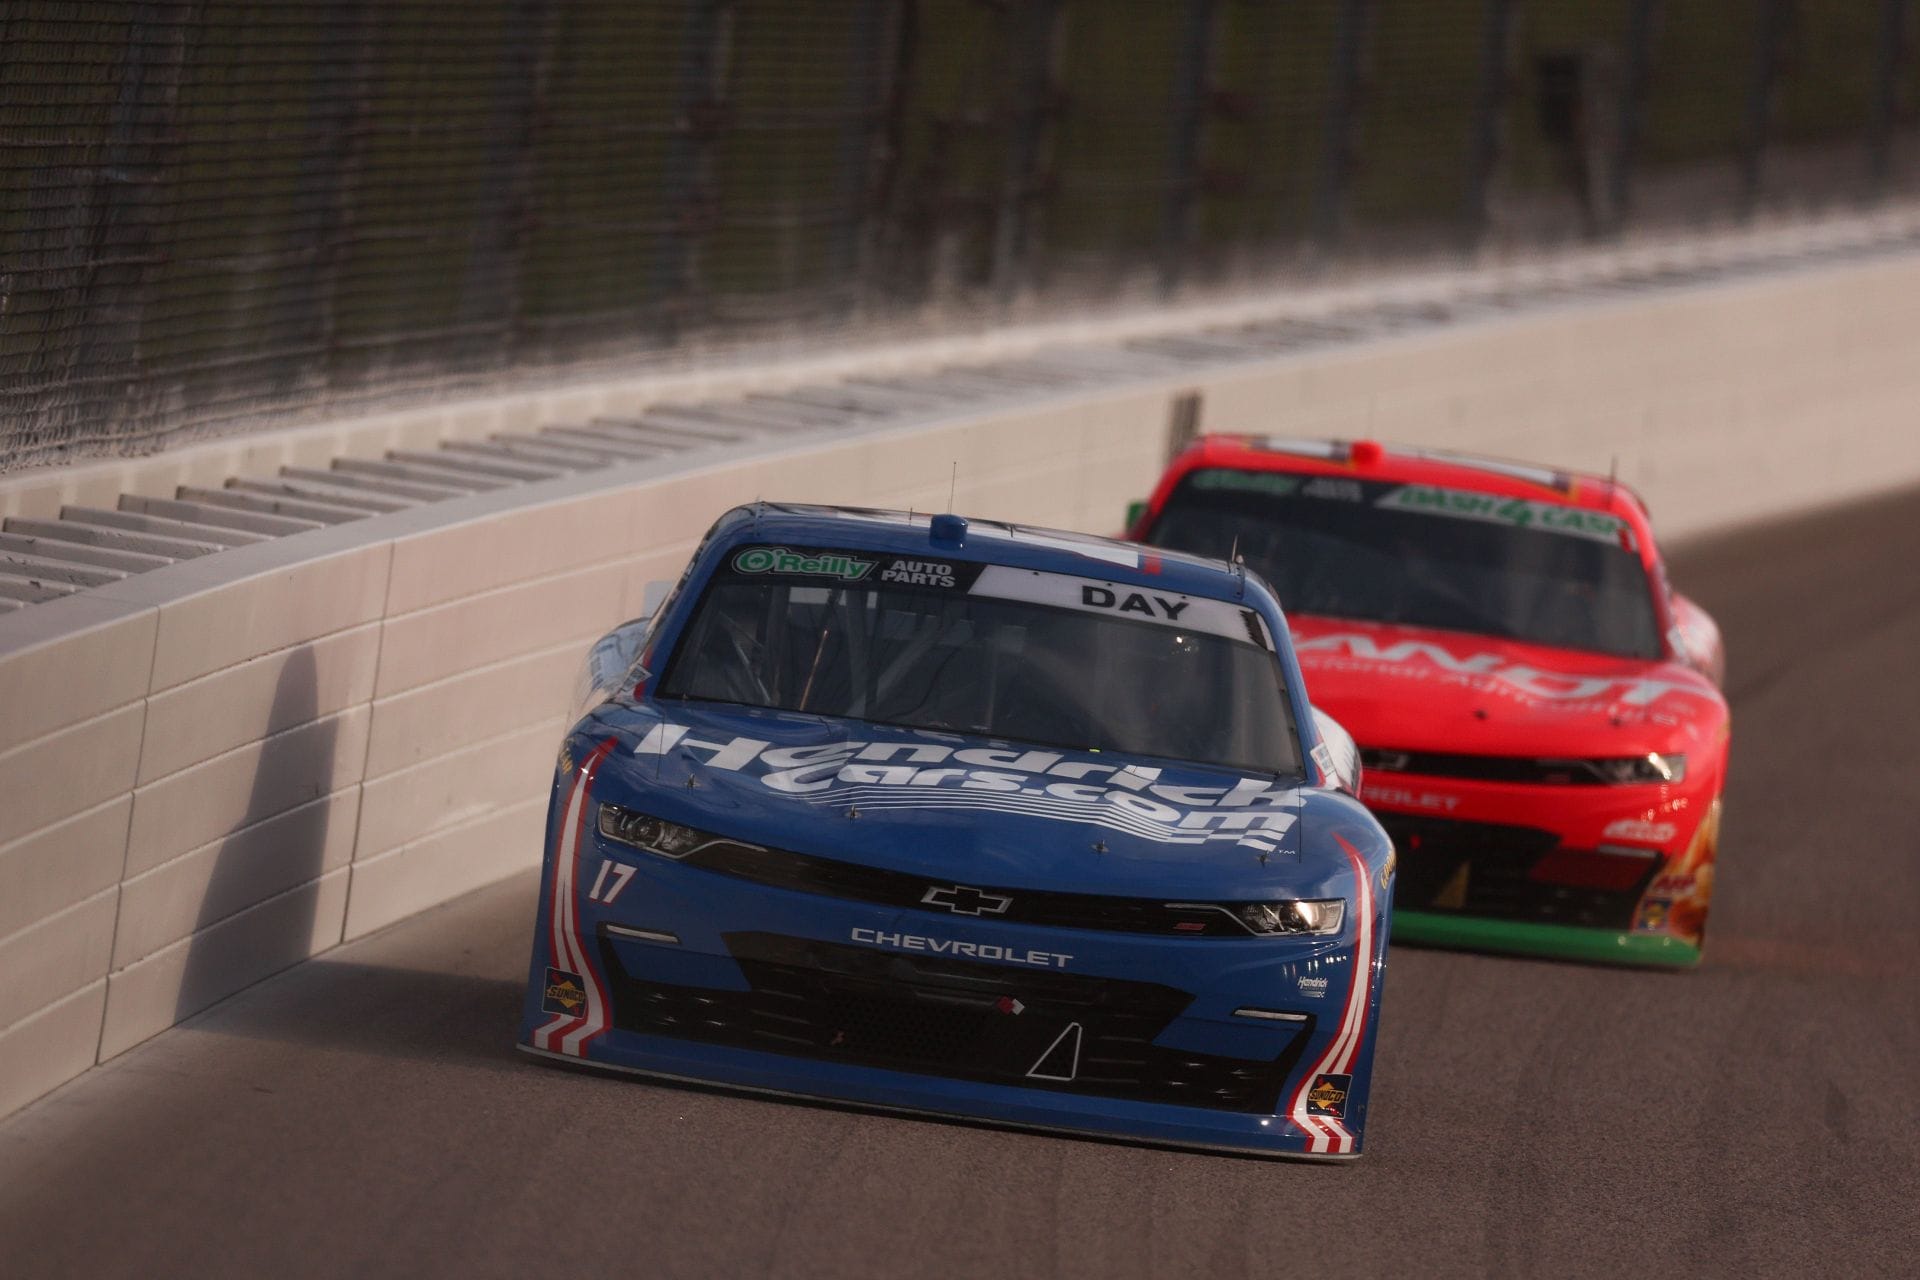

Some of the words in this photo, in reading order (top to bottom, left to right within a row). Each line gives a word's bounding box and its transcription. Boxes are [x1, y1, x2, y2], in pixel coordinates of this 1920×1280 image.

[736, 547, 867, 578] O'Reilly
[881, 569, 956, 588] PARTS
[890, 560, 952, 576] AUTO
[1081, 585, 1190, 621] DAY
[633, 723, 1307, 807] Hendrick
[760, 756, 1299, 852] Cars.com
[589, 859, 639, 906] 17
[851, 927, 1075, 968] CHEVROLET
[1297, 975, 1329, 990] Hendrick
[1308, 1088, 1344, 1103] SUNOCO
